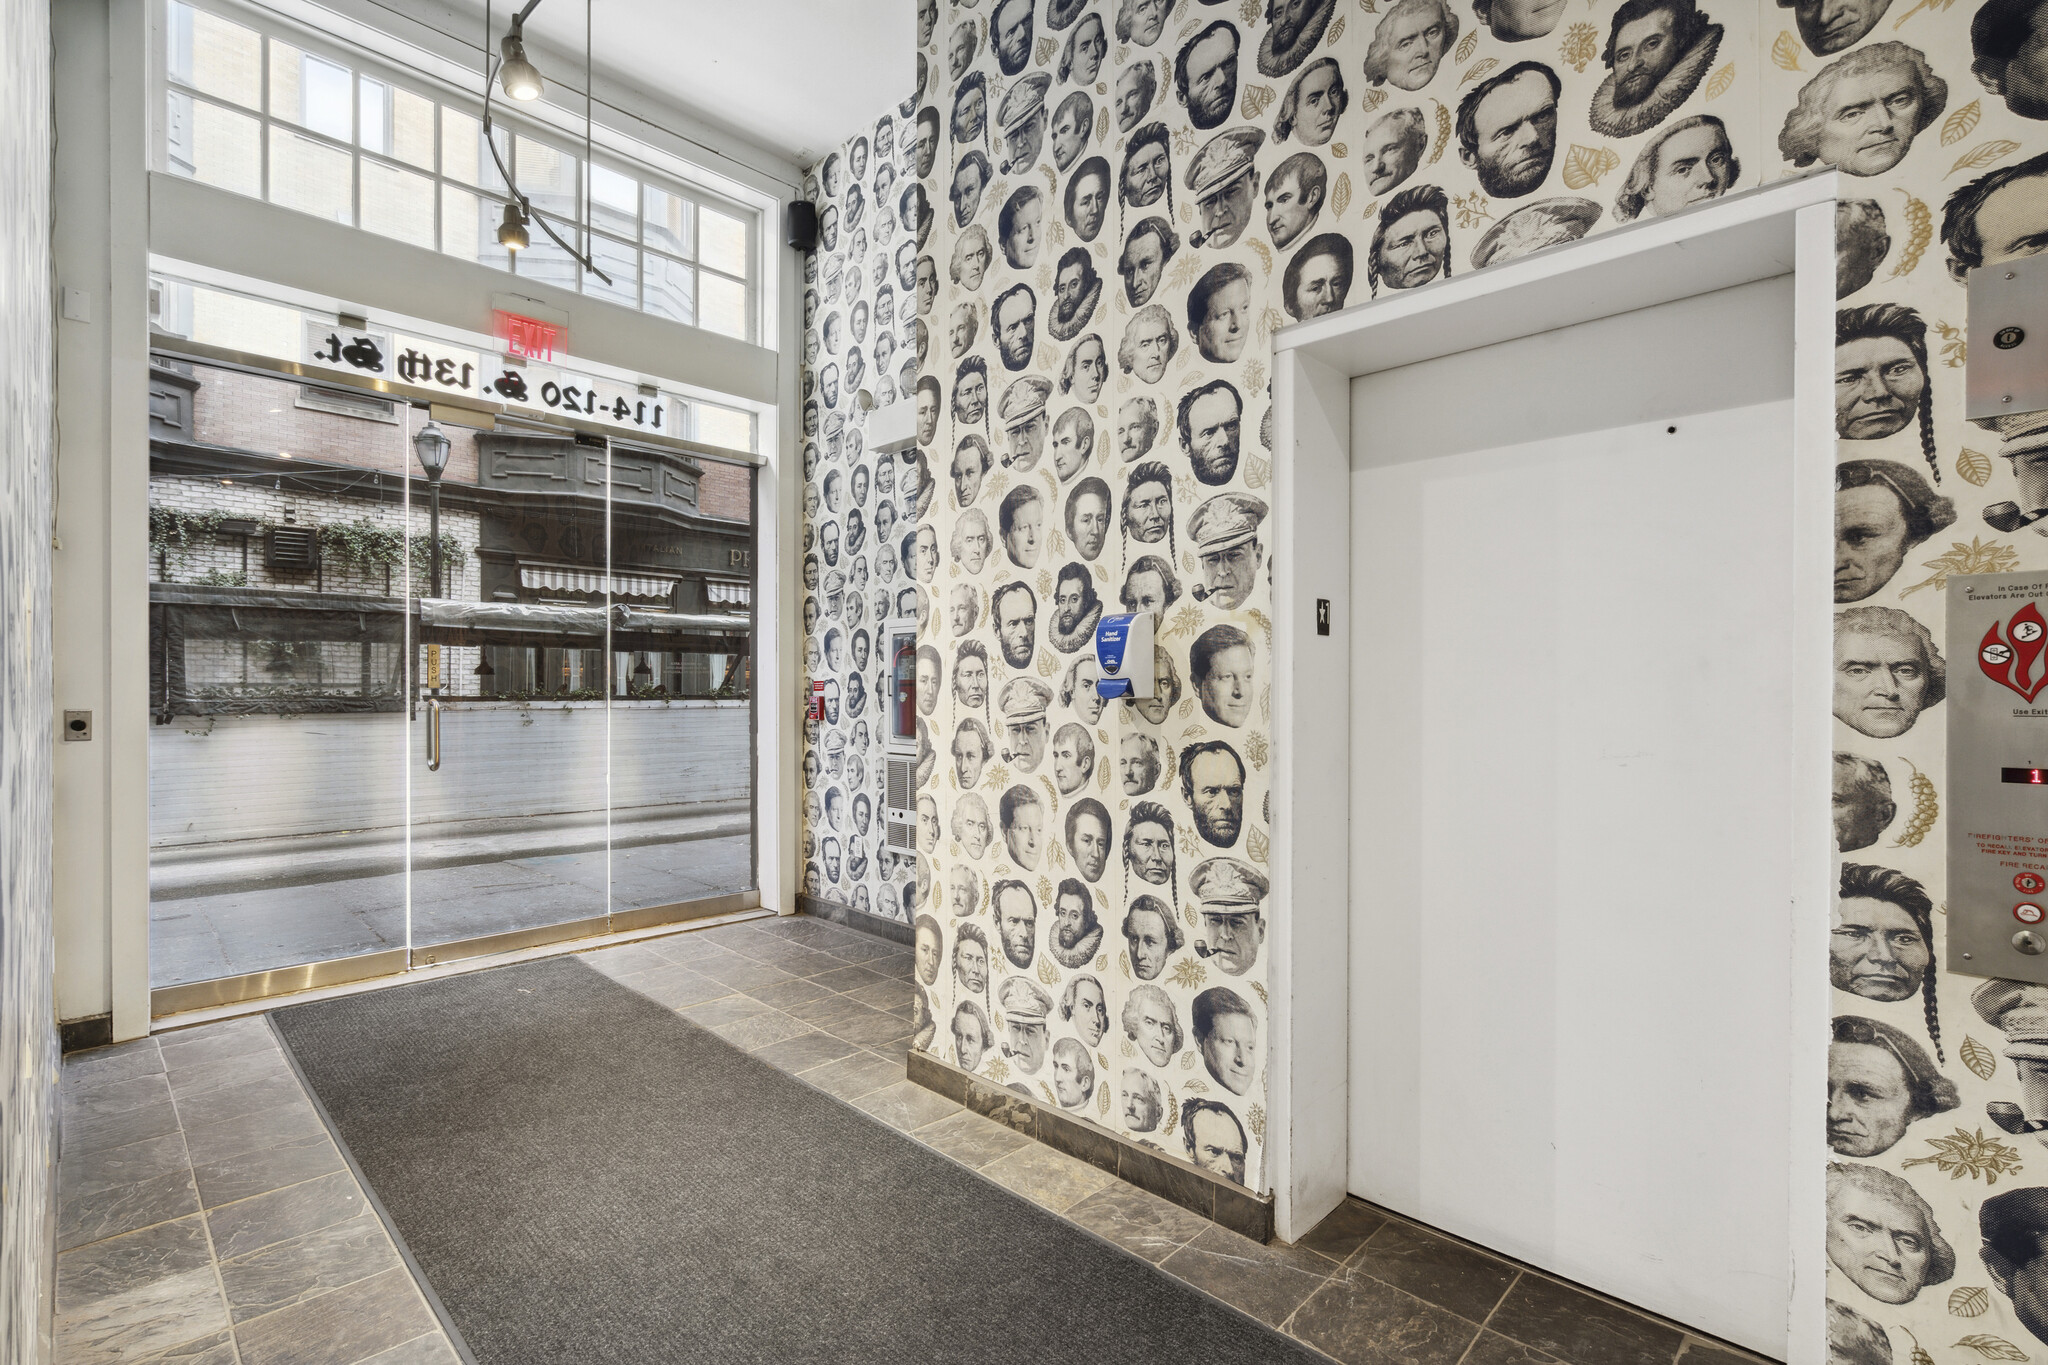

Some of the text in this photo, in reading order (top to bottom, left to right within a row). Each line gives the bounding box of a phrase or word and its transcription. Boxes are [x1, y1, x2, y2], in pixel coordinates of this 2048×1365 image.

[508, 318, 557, 362] EXIT
[430, 650, 438, 682] PUSH
[2031, 769, 2041, 783] 1
[2000, 860, 2020, 868] FIRE
